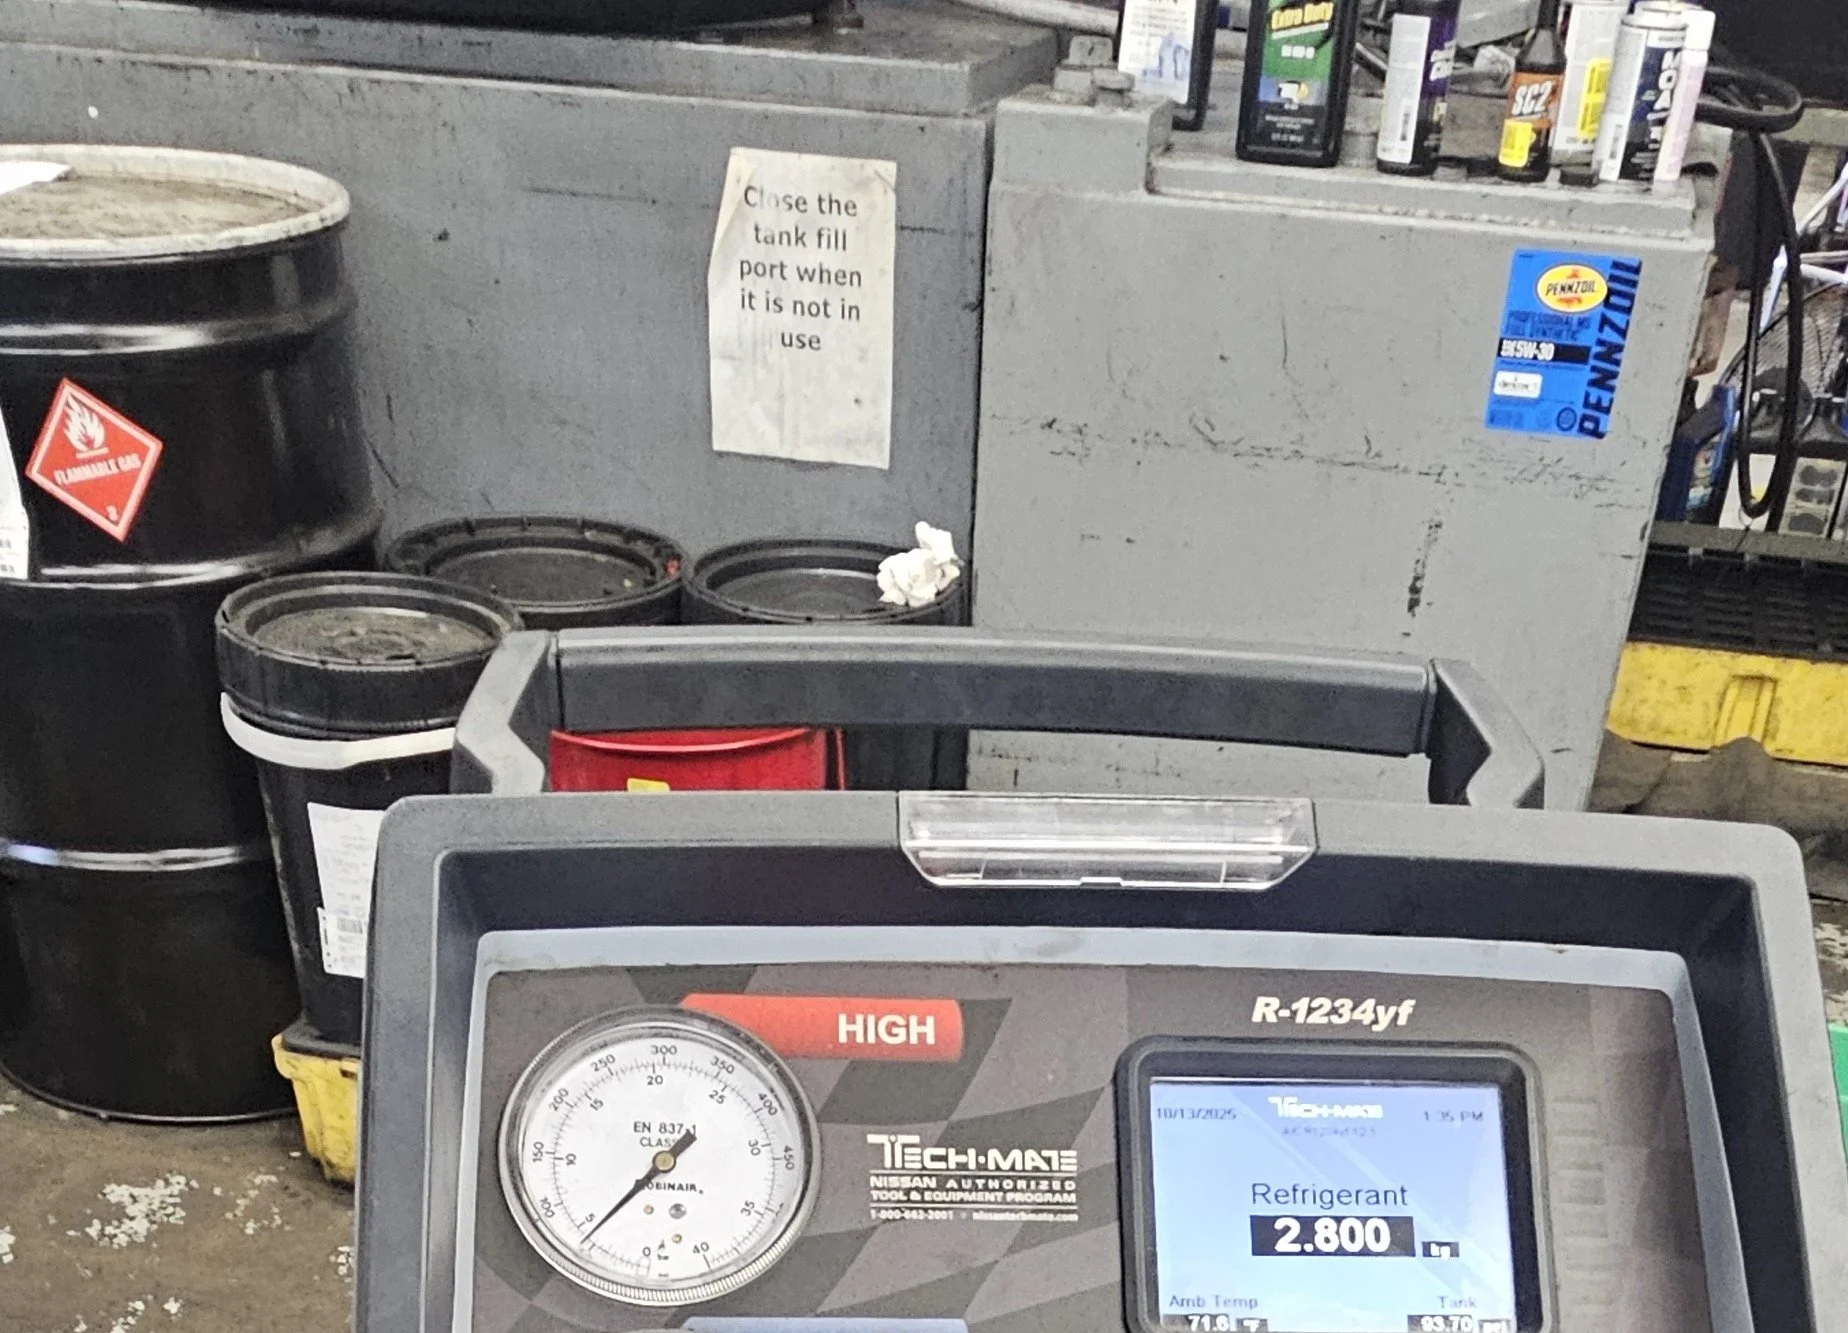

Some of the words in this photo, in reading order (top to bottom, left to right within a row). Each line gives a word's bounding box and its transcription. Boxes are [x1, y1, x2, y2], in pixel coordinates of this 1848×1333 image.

[1511, 80, 1552, 115] SC2
[744, 185, 807, 213] Close
[818, 193, 857, 217] the
[754, 223, 807, 248] tank
[817, 227, 846, 251] fill
[740, 259, 787, 281] port
[796, 262, 861, 287] when
[1546, 281, 1596, 296] PENNZOIL
[741, 288, 756, 311] it
[765, 290, 783, 314] is
[793, 299, 831, 318] not
[841, 298, 860, 321] in
[781, 332, 821, 351] use
[1577, 260, 1642, 439] PENNZOIL
[54, 459, 117, 485] FLAMMABLE
[1252, 997, 1415, 1031] R-1234yf
[838, 1013, 935, 1045] HIGH
[651, 1045, 677, 1056] 300
[590, 1054, 616, 1072] 250
[710, 1056, 735, 1075] 350
[647, 1075, 663, 1086] 20
[548, 1088, 570, 1112] 200
[590, 1099, 604, 1112] 15
[708, 1090, 726, 1105] 25
[758, 1092, 778, 1117] 400
[1157, 1108, 1236, 1120] 10/13/2025
[1461, 1111, 1483, 1122] PM
[633, 1121, 651, 1133] EN
[532, 1141, 544, 1163] 150
[748, 1139, 761, 1156] 30
[565, 1153, 577, 1166] 10
[783, 1145, 795, 1170] 450
[870, 1176, 937, 1188] NISSAN
[946, 1179, 1075, 1191] AUTHORIZED
[871, 1190, 907, 1201] TOOL
[924, 1191, 1004, 1202] EQUIPMENT
[1006, 1192, 1076, 1204] PROGRAM
[1252, 1183, 1408, 1210] Refrigerant
[539, 1197, 555, 1219] 100
[740, 1200, 755, 1217] 35
[1273, 1218, 1391, 1254] 2.800
[642, 1247, 652, 1257] 0
[693, 1242, 710, 1254] 40
[1169, 1295, 1205, 1308] Amb
[1214, 1295, 1258, 1310] Temp
[1437, 1295, 1477, 1309] Tank
